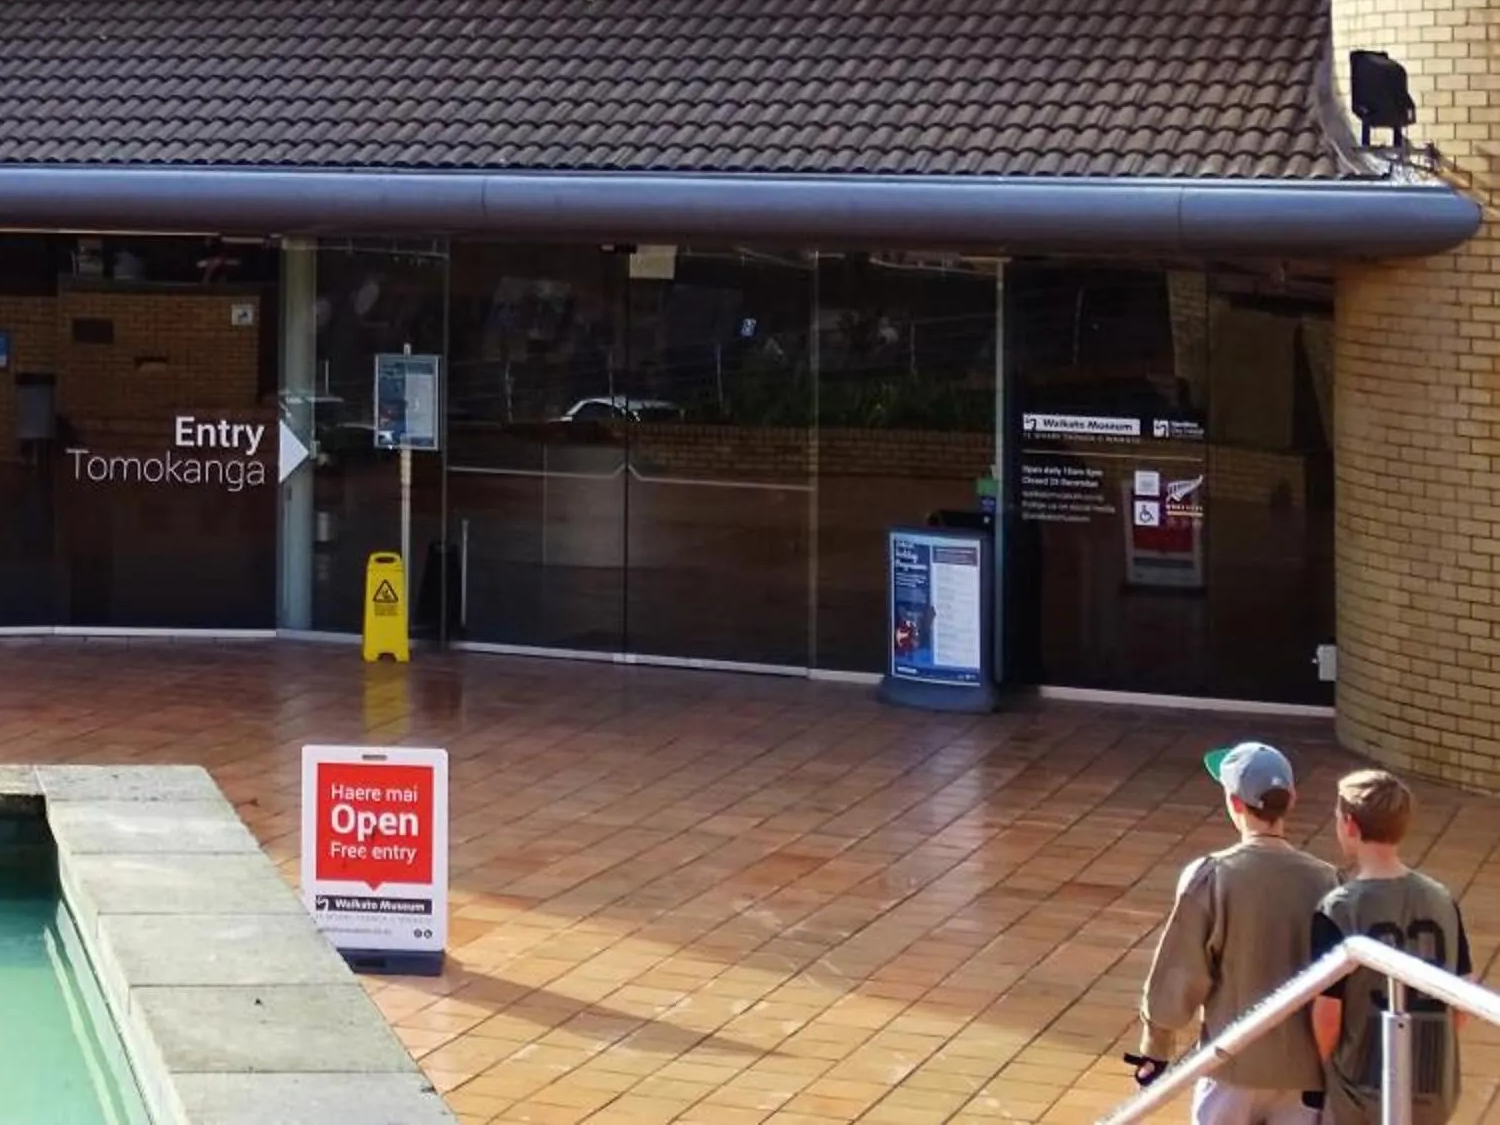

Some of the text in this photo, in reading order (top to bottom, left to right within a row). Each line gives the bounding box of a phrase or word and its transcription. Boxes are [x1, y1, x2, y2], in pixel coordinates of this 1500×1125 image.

[175, 415, 265, 456] Entry
[1043, 418, 1133, 431] Waikato Museum
[66, 448, 265, 492] Tomokanga
[331, 784, 418, 802] Haere mai
[331, 804, 419, 842] Open
[331, 842, 417, 864] Free entry
[334, 898, 425, 911] Waikato Museum
